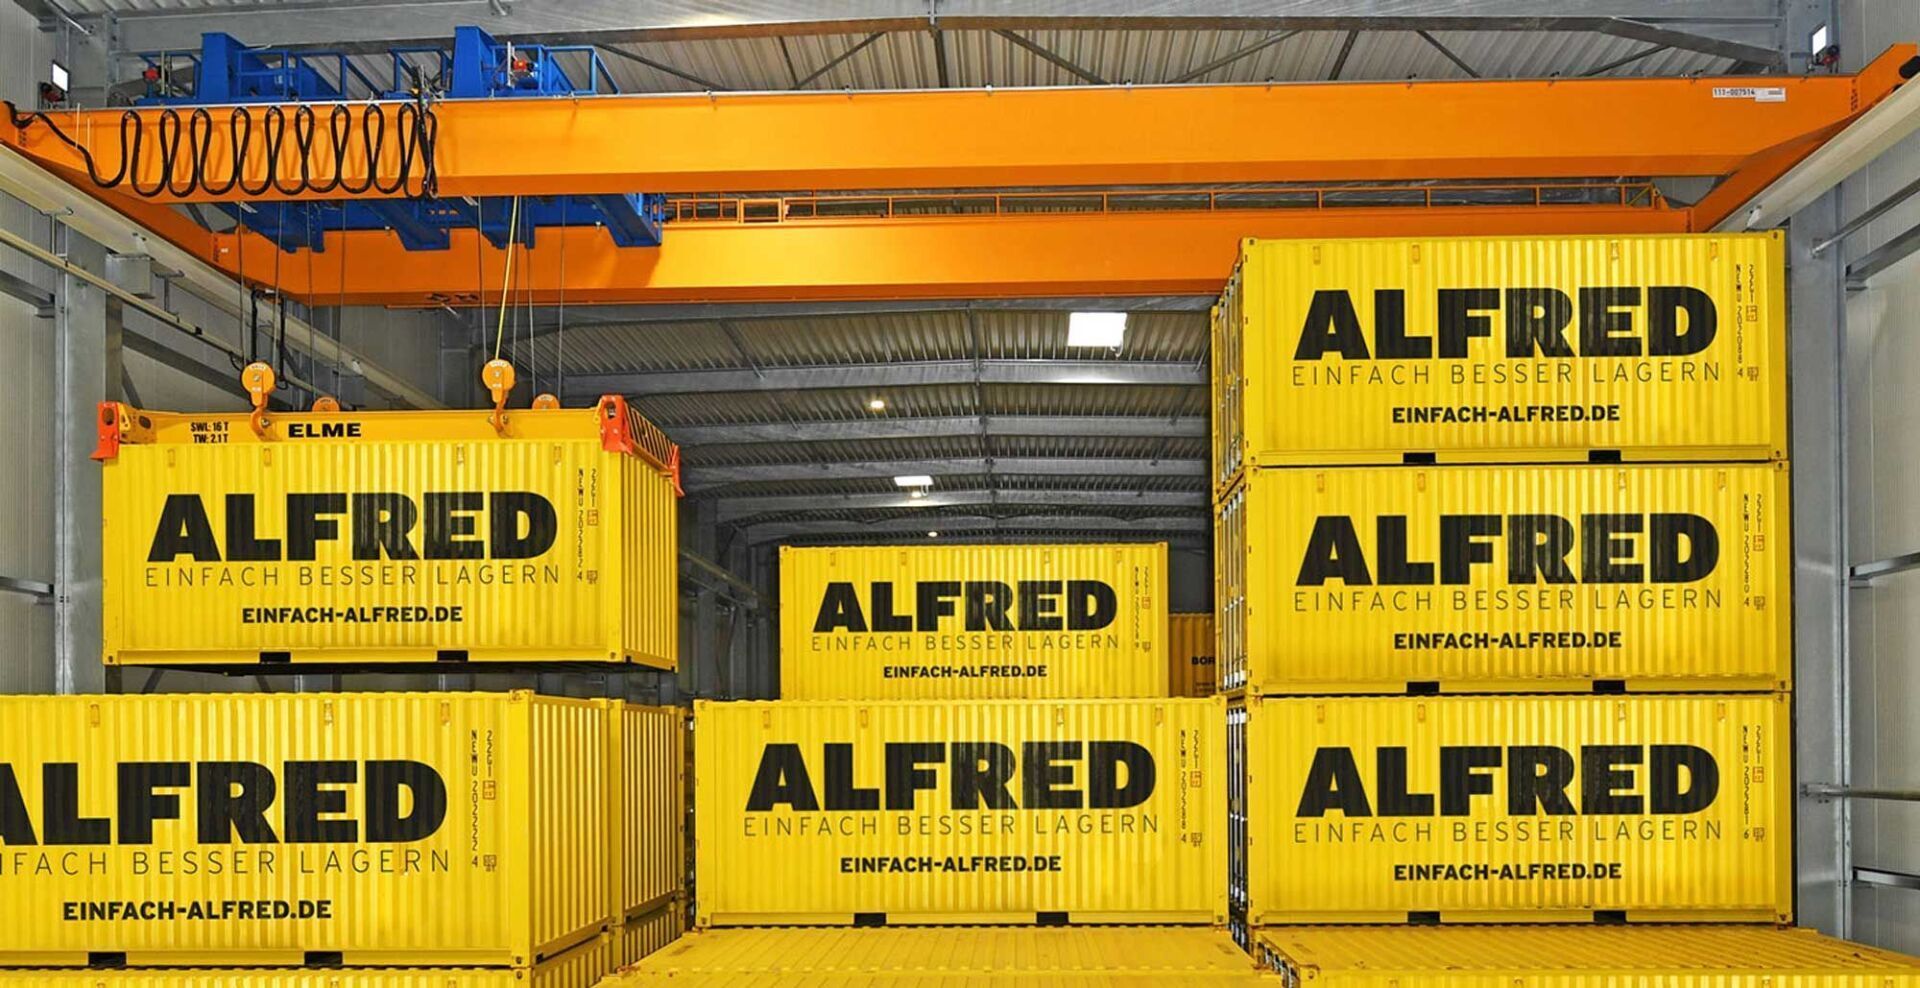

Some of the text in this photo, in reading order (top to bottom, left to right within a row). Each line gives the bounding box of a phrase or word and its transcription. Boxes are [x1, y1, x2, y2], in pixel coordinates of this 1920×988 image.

[1293, 286, 1718, 360] ALFRED
[1293, 361, 1719, 386] EINFACH BESSER LAGERN
[1392, 405, 1620, 423] EINFACH-ALFRED.DE
[211, 421, 222, 433] 16
[223, 421, 229, 432] T
[288, 423, 361, 438] ELME
[223, 433, 229, 444] T
[147, 491, 558, 563] ALFRED
[1295, 513, 1720, 586] ALFRED
[146, 565, 558, 587] EINFACH BESSER LAGERN
[813, 580, 1117, 633] ALFRED
[1295, 589, 1720, 611] EINFACH BESSER LAGERN
[242, 606, 462, 624] EINFACH-ALFRED.DE
[812, 634, 1119, 651] EINFACH BESSER LAGERN
[1394, 631, 1621, 649] EINFACH-ALFRED.DE
[883, 665, 1047, 678] EINFACH-ALFRED.DE
[745, 740, 1156, 812] ALFRED
[1296, 744, 1720, 817] ALFRED
[744, 814, 1157, 836] EINFACH BESSER LAGERN
[1295, 820, 1720, 843] EINFACH BESSER LAGERN
[0, 849, 448, 876] FACH BESSER LAGERN
[841, 856, 1061, 873] EINFACH-ALFRED.DE
[1394, 863, 1621, 881] EINFACH-ALFRED.DE
[63, 900, 332, 921] EINFACH-ALFRED.DE
